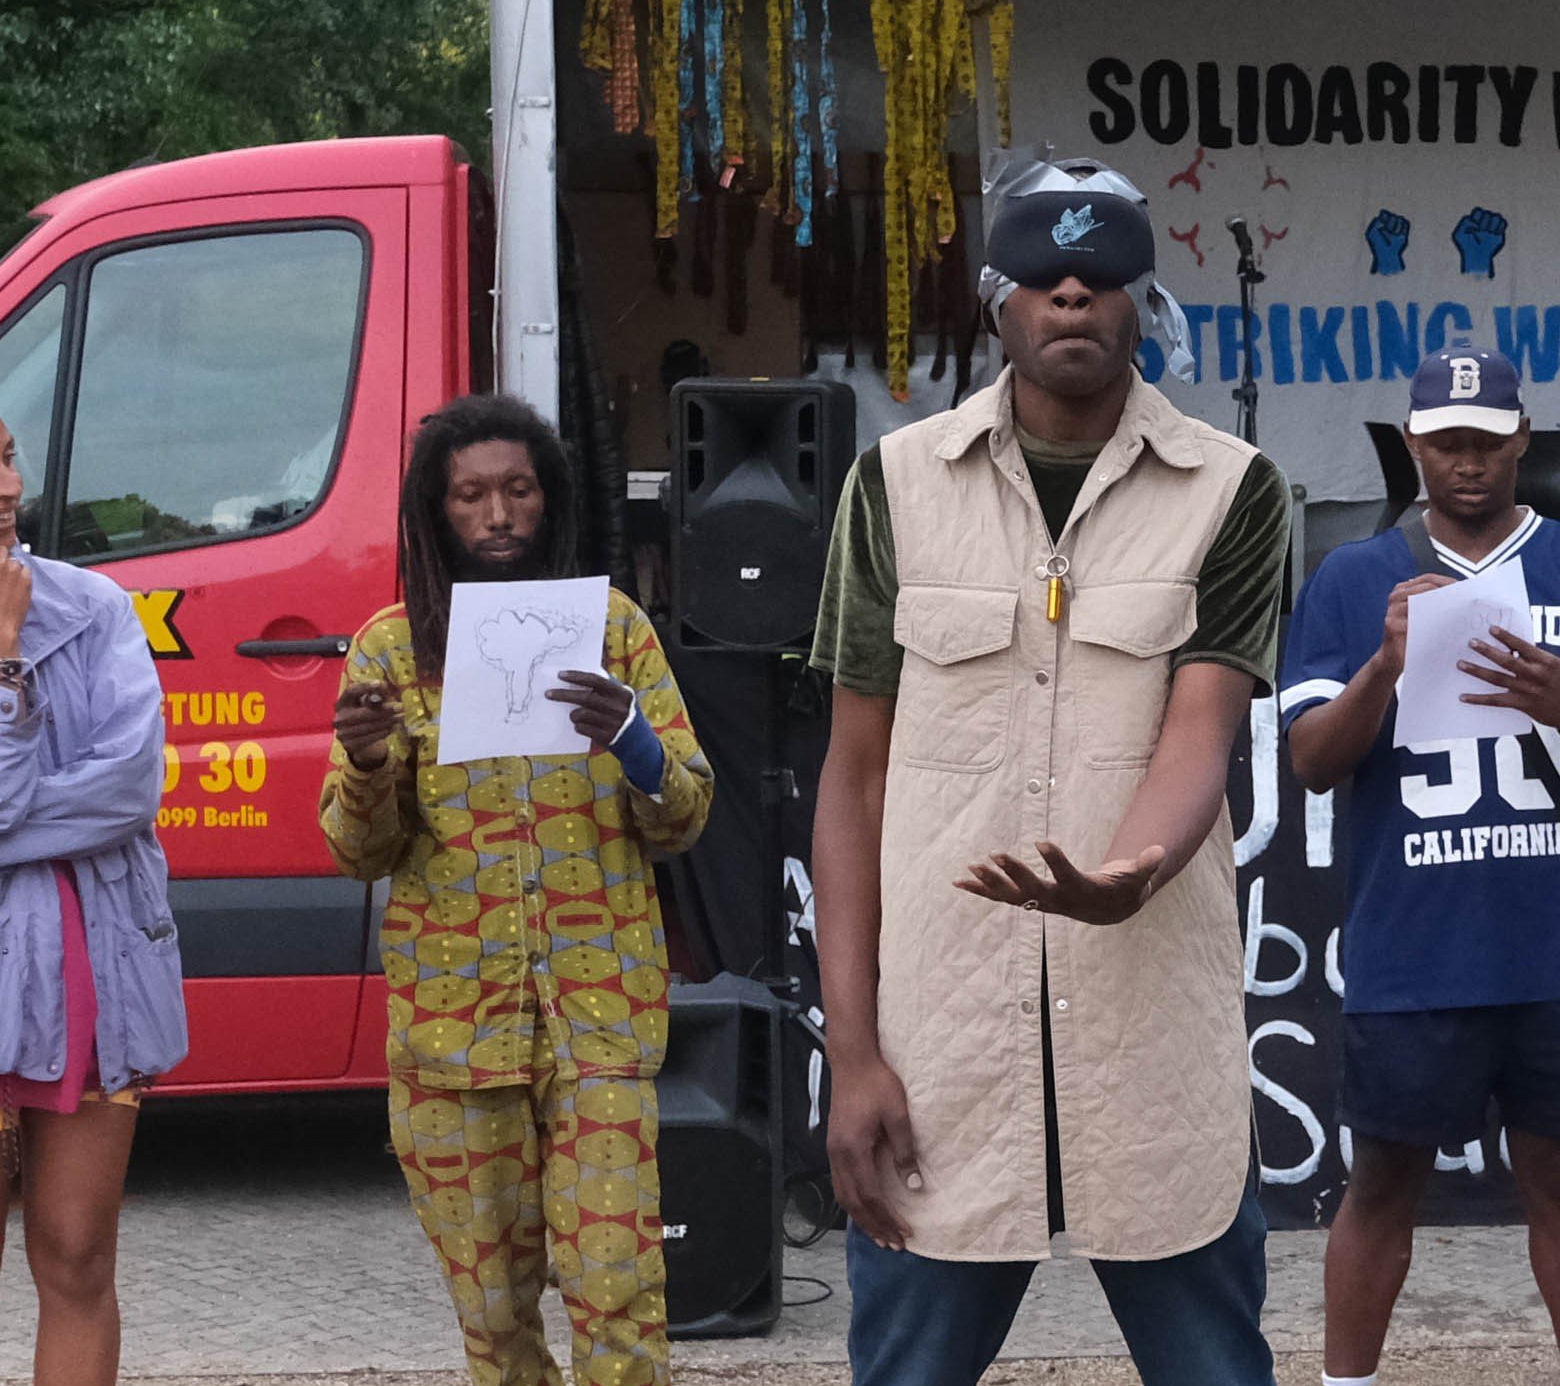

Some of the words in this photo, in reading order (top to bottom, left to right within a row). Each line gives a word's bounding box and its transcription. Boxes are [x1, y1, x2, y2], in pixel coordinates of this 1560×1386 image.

[1086, 57, 1538, 149] SOLIDARITY
[1449, 357, 1481, 400] B
[198, 741, 267, 794] 30
[154, 807, 197, 828] 099
[203, 804, 269, 828] Berlin
